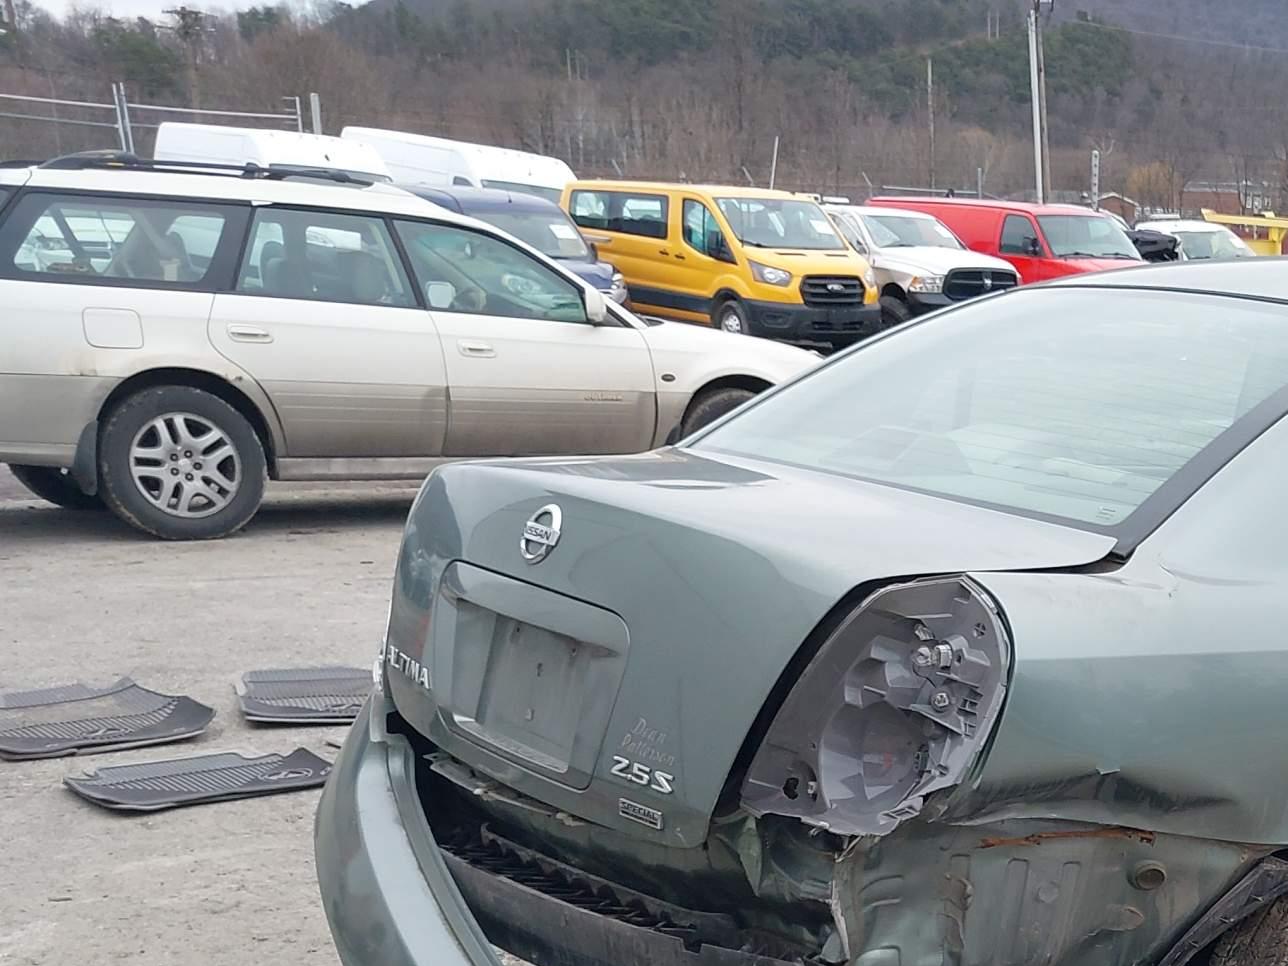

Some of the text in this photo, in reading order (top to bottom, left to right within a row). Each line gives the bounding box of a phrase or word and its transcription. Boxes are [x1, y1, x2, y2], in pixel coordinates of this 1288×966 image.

[525, 525, 552, 541] ISSAN
[387, 645, 432, 690] ALTIMA
[621, 801, 658, 821] SPECIAL
